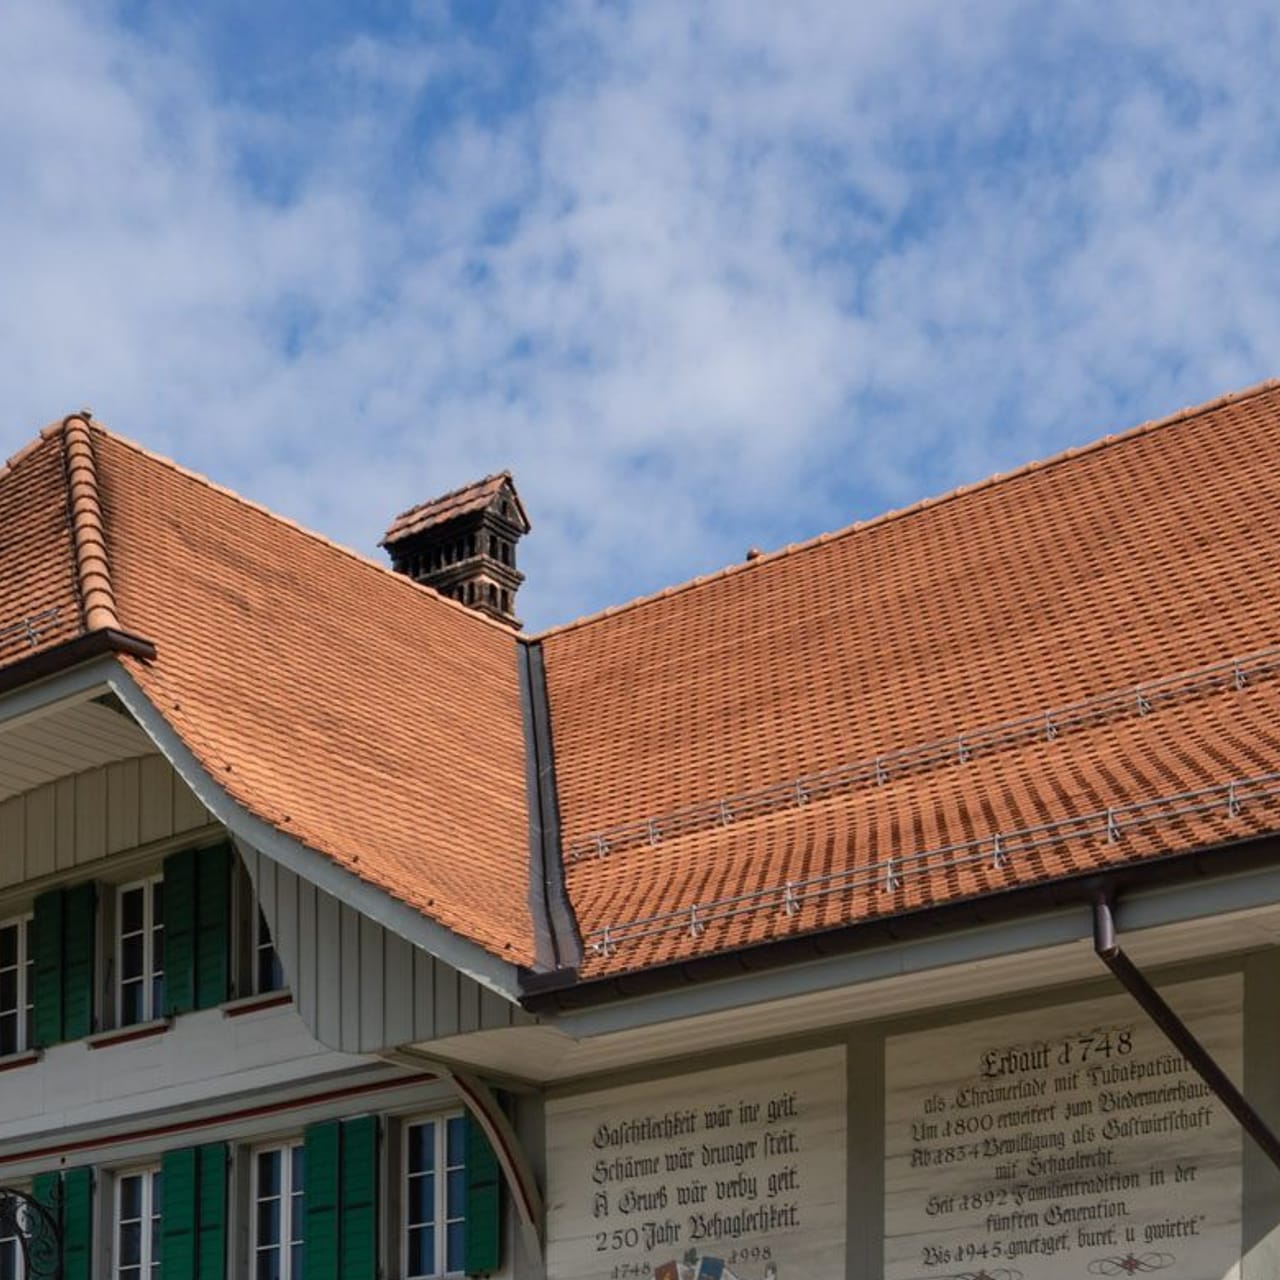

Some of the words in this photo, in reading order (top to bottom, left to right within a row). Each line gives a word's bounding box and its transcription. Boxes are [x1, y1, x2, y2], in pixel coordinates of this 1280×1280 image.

[979, 1043, 1051, 1081] Erbaut
[1057, 1030, 1134, 1067] 1748
[923, 1092, 946, 1116] als
[1054, 1070, 1081, 1093] mit
[704, 1103, 733, 1130] wär
[911, 1118, 939, 1142] Um
[942, 1114, 994, 1138] 1800
[997, 1101, 1056, 1129] erweitert
[1064, 1097, 1093, 1121] zum
[982, 1129, 1066, 1160] Bewilligung
[1072, 1119, 1095, 1143] als
[592, 1154, 660, 1185] Schärme
[665, 1147, 695, 1172] wär
[701, 1138, 758, 1168] drunger
[995, 1160, 1018, 1181] mit
[676, 1179, 708, 1206] wär
[925, 1192, 954, 1216] Seit
[958, 1188, 1008, 1211] 1892
[1011, 1168, 1140, 1207] Familientradition
[1150, 1164, 1165, 1185] in
[1175, 1163, 1198, 1183] der
[595, 1227, 639, 1252] 250
[641, 1218, 681, 1251] Jahr
[986, 1204, 1040, 1234] fünften
[728, 1246, 772, 1265] 1998
[923, 1244, 951, 1267] Bis
[954, 1240, 1002, 1266] 1945
[611, 1261, 651, 1280] 1748
